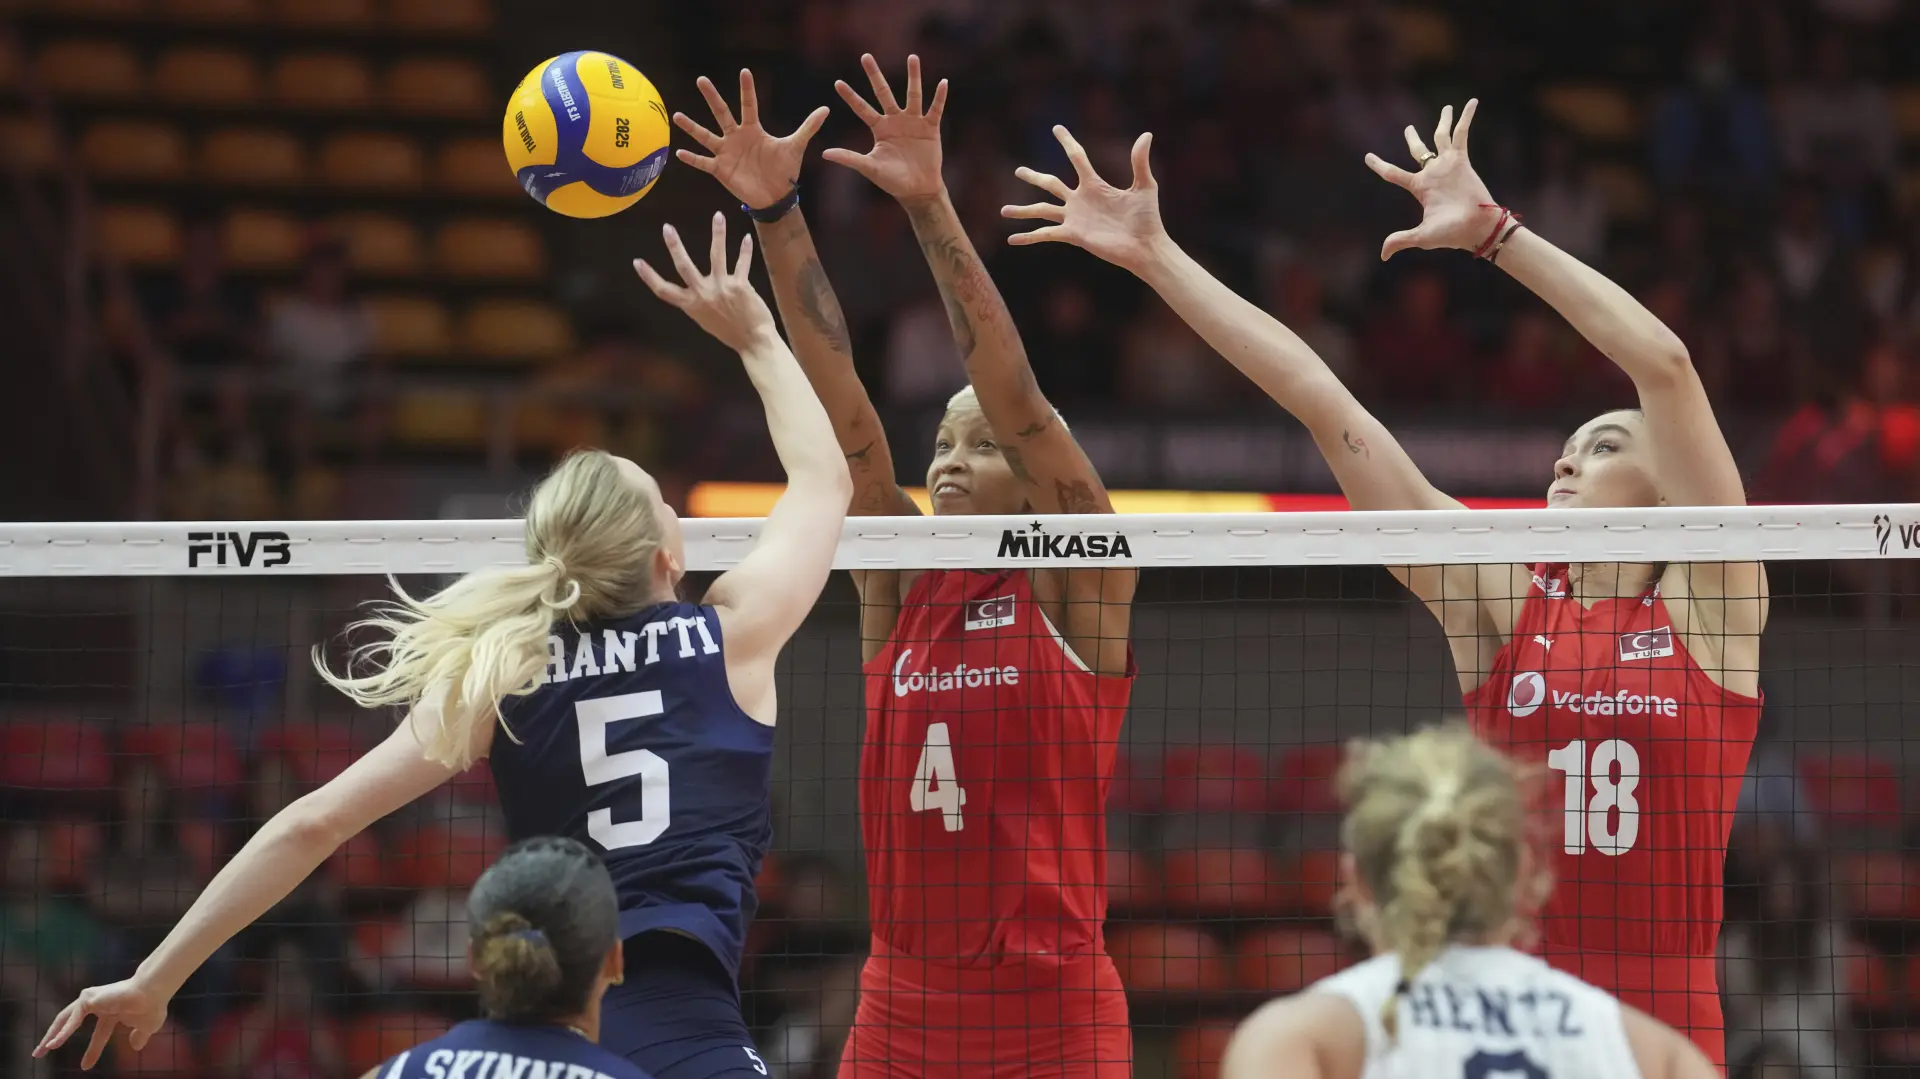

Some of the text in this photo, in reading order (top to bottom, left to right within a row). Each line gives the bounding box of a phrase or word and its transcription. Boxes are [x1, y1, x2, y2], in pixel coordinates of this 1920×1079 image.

[515, 110, 537, 154] THAILAND
[616, 117, 630, 148] 2025
[997, 529, 1132, 558] MIKASA
[977, 618, 1004, 628] TUR
[541, 616, 721, 684] RANTTI
[1632, 649, 1661, 659] TUR
[908, 664, 1019, 693] odafone
[574, 689, 671, 851] 5
[910, 722, 967, 832] 4
[1548, 738, 1640, 856] 18
[742, 1046, 768, 1075] 5
